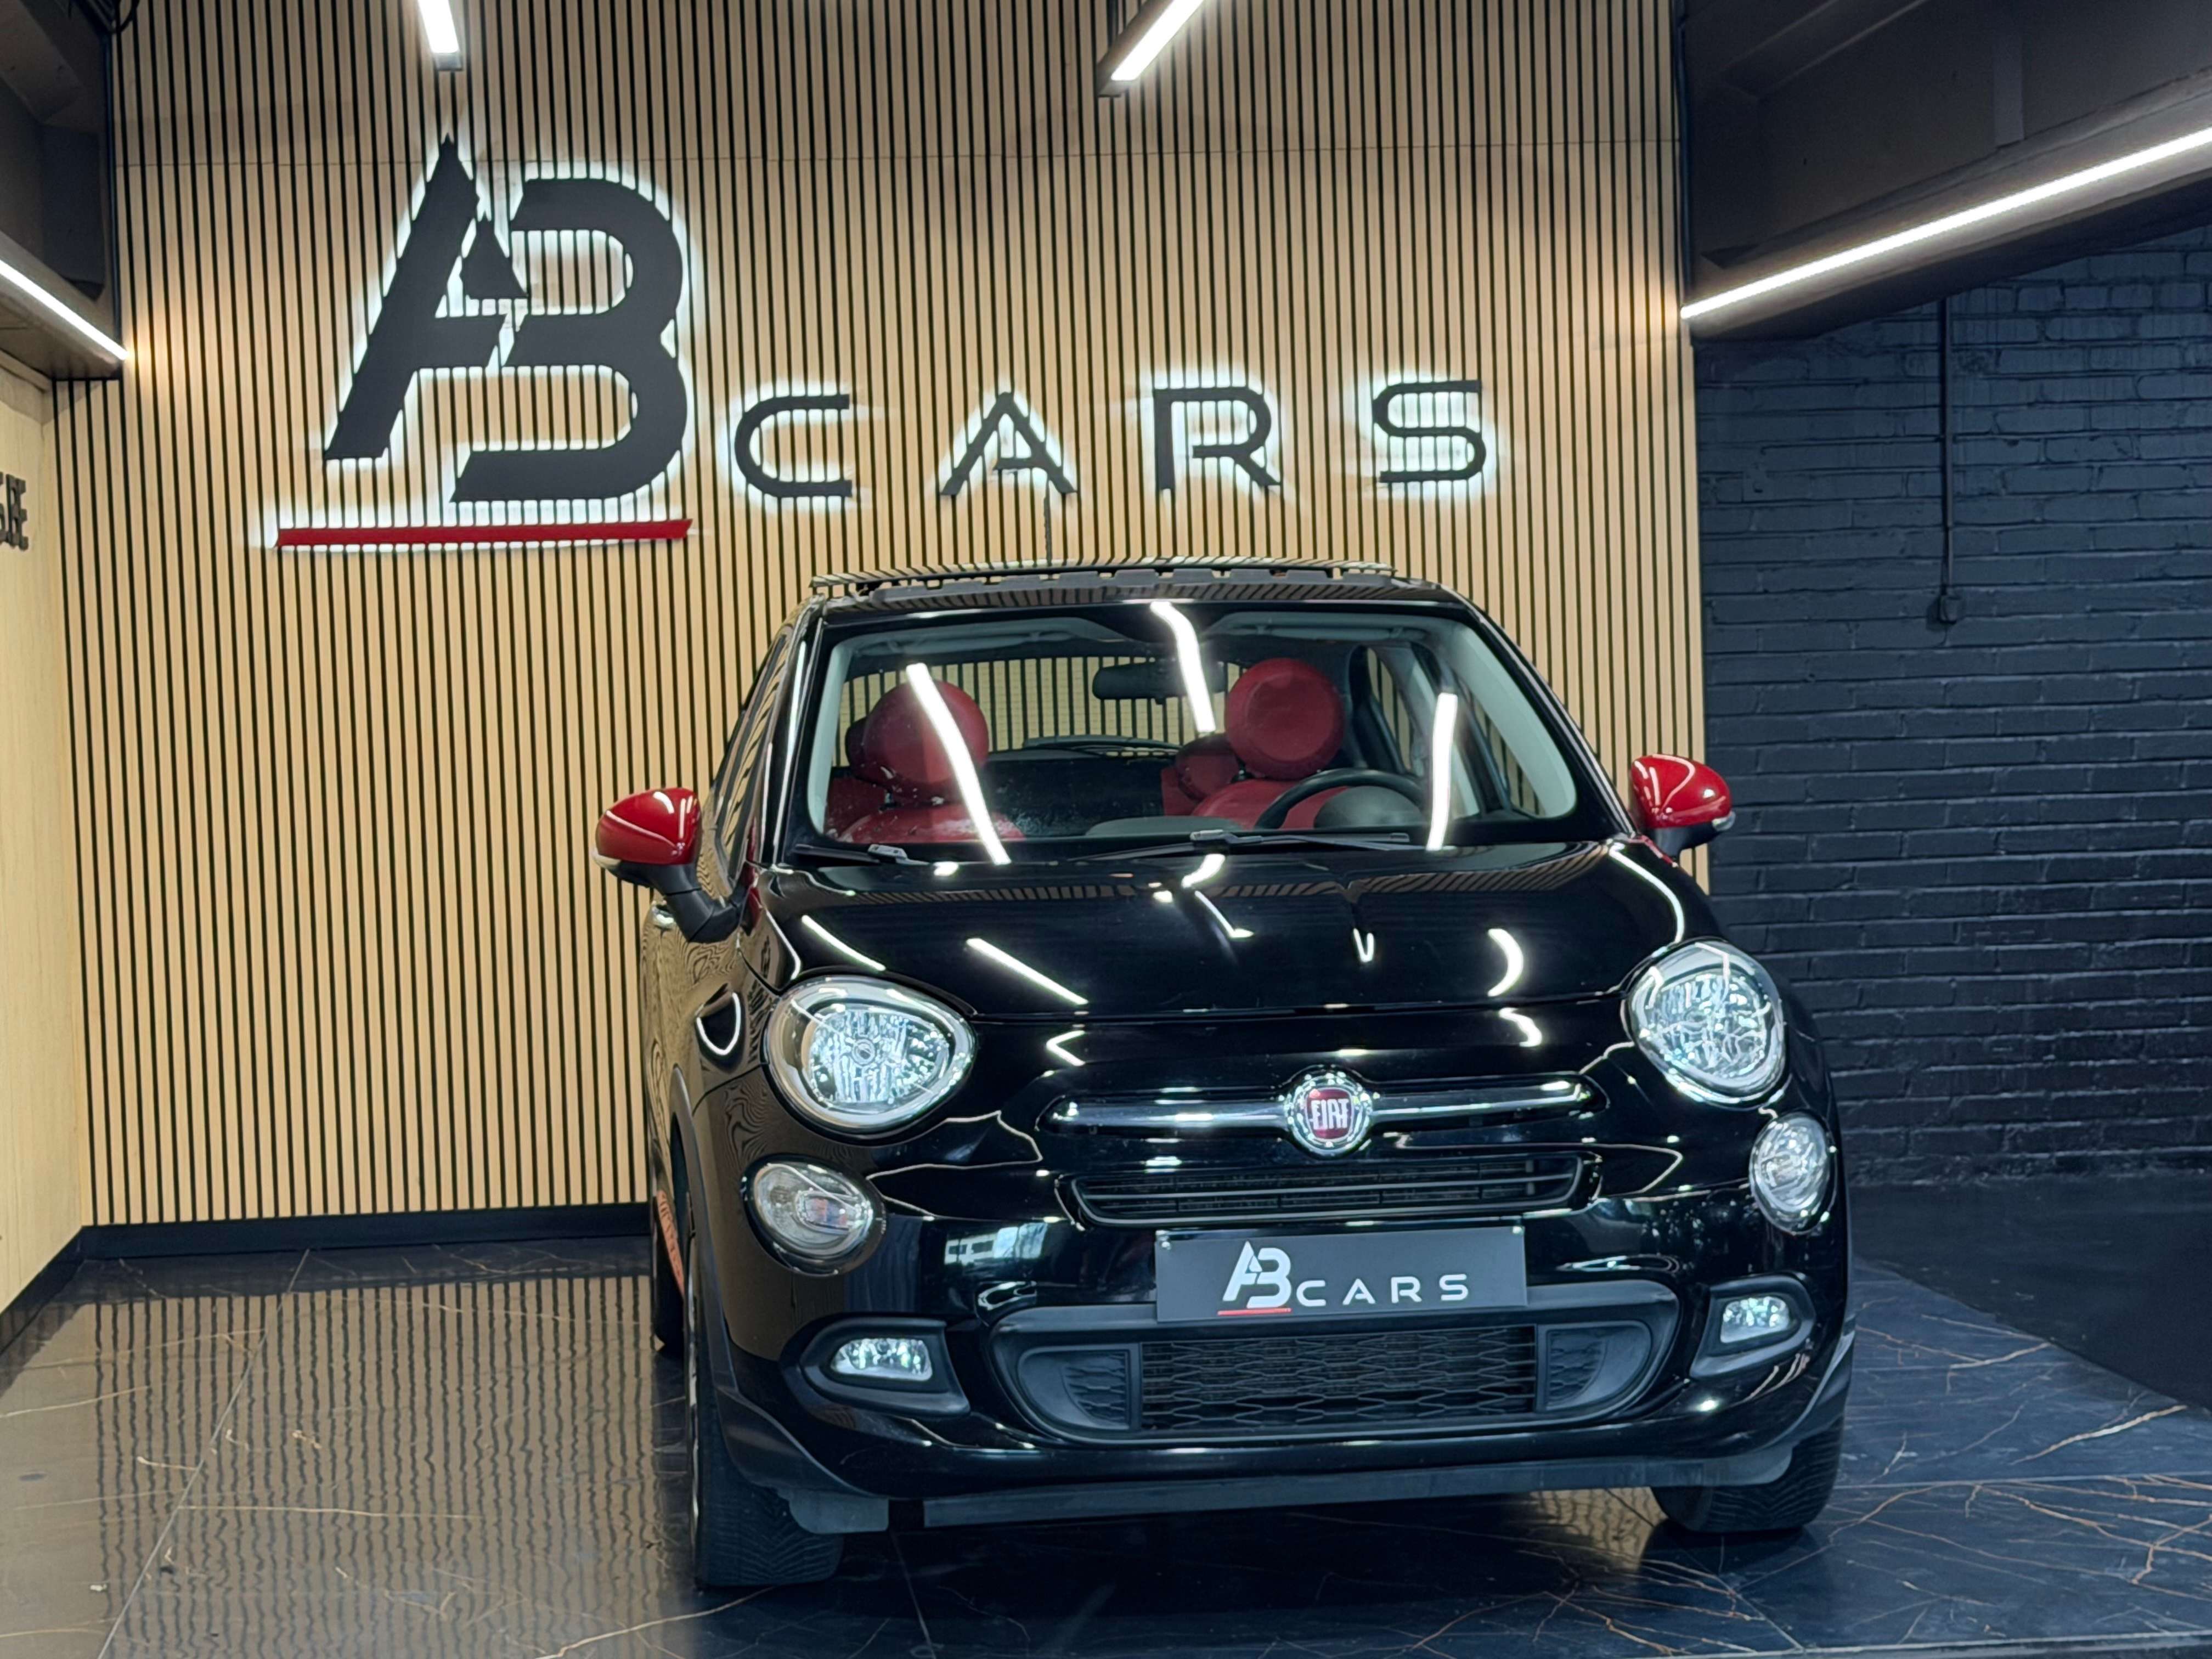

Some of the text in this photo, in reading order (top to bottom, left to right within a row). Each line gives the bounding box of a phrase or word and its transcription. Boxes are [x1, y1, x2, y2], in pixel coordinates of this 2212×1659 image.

[324, 133, 1487, 504] AB CARS
[1310, 1098, 1349, 1130] FIAT
[1223, 1240, 1469, 1308] AB CARS
